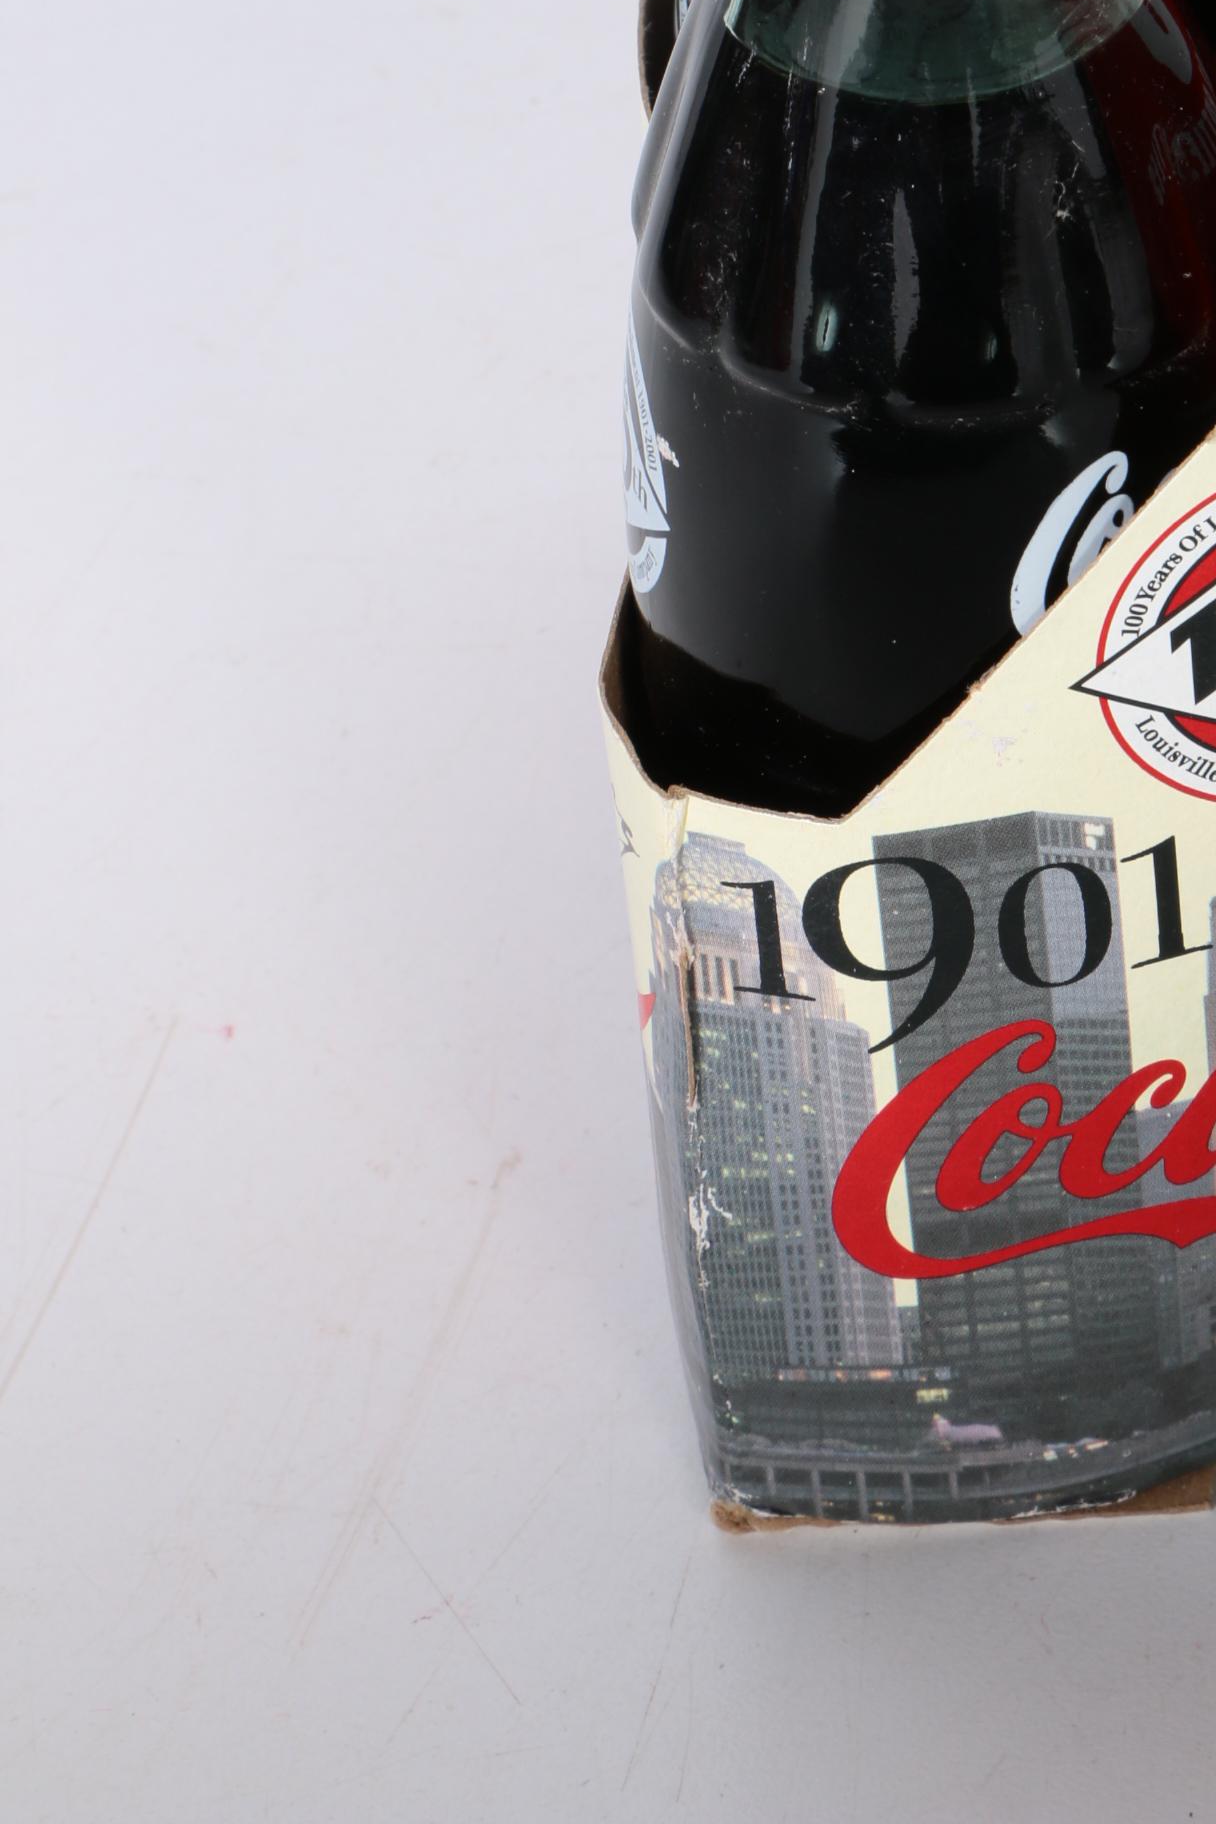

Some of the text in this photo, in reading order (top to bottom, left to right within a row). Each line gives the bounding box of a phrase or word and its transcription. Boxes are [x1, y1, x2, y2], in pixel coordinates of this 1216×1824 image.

[1137, 555, 1183, 604] Years
[1178, 525, 1208, 554] Of
[721, 835, 1214, 1054] 1901
